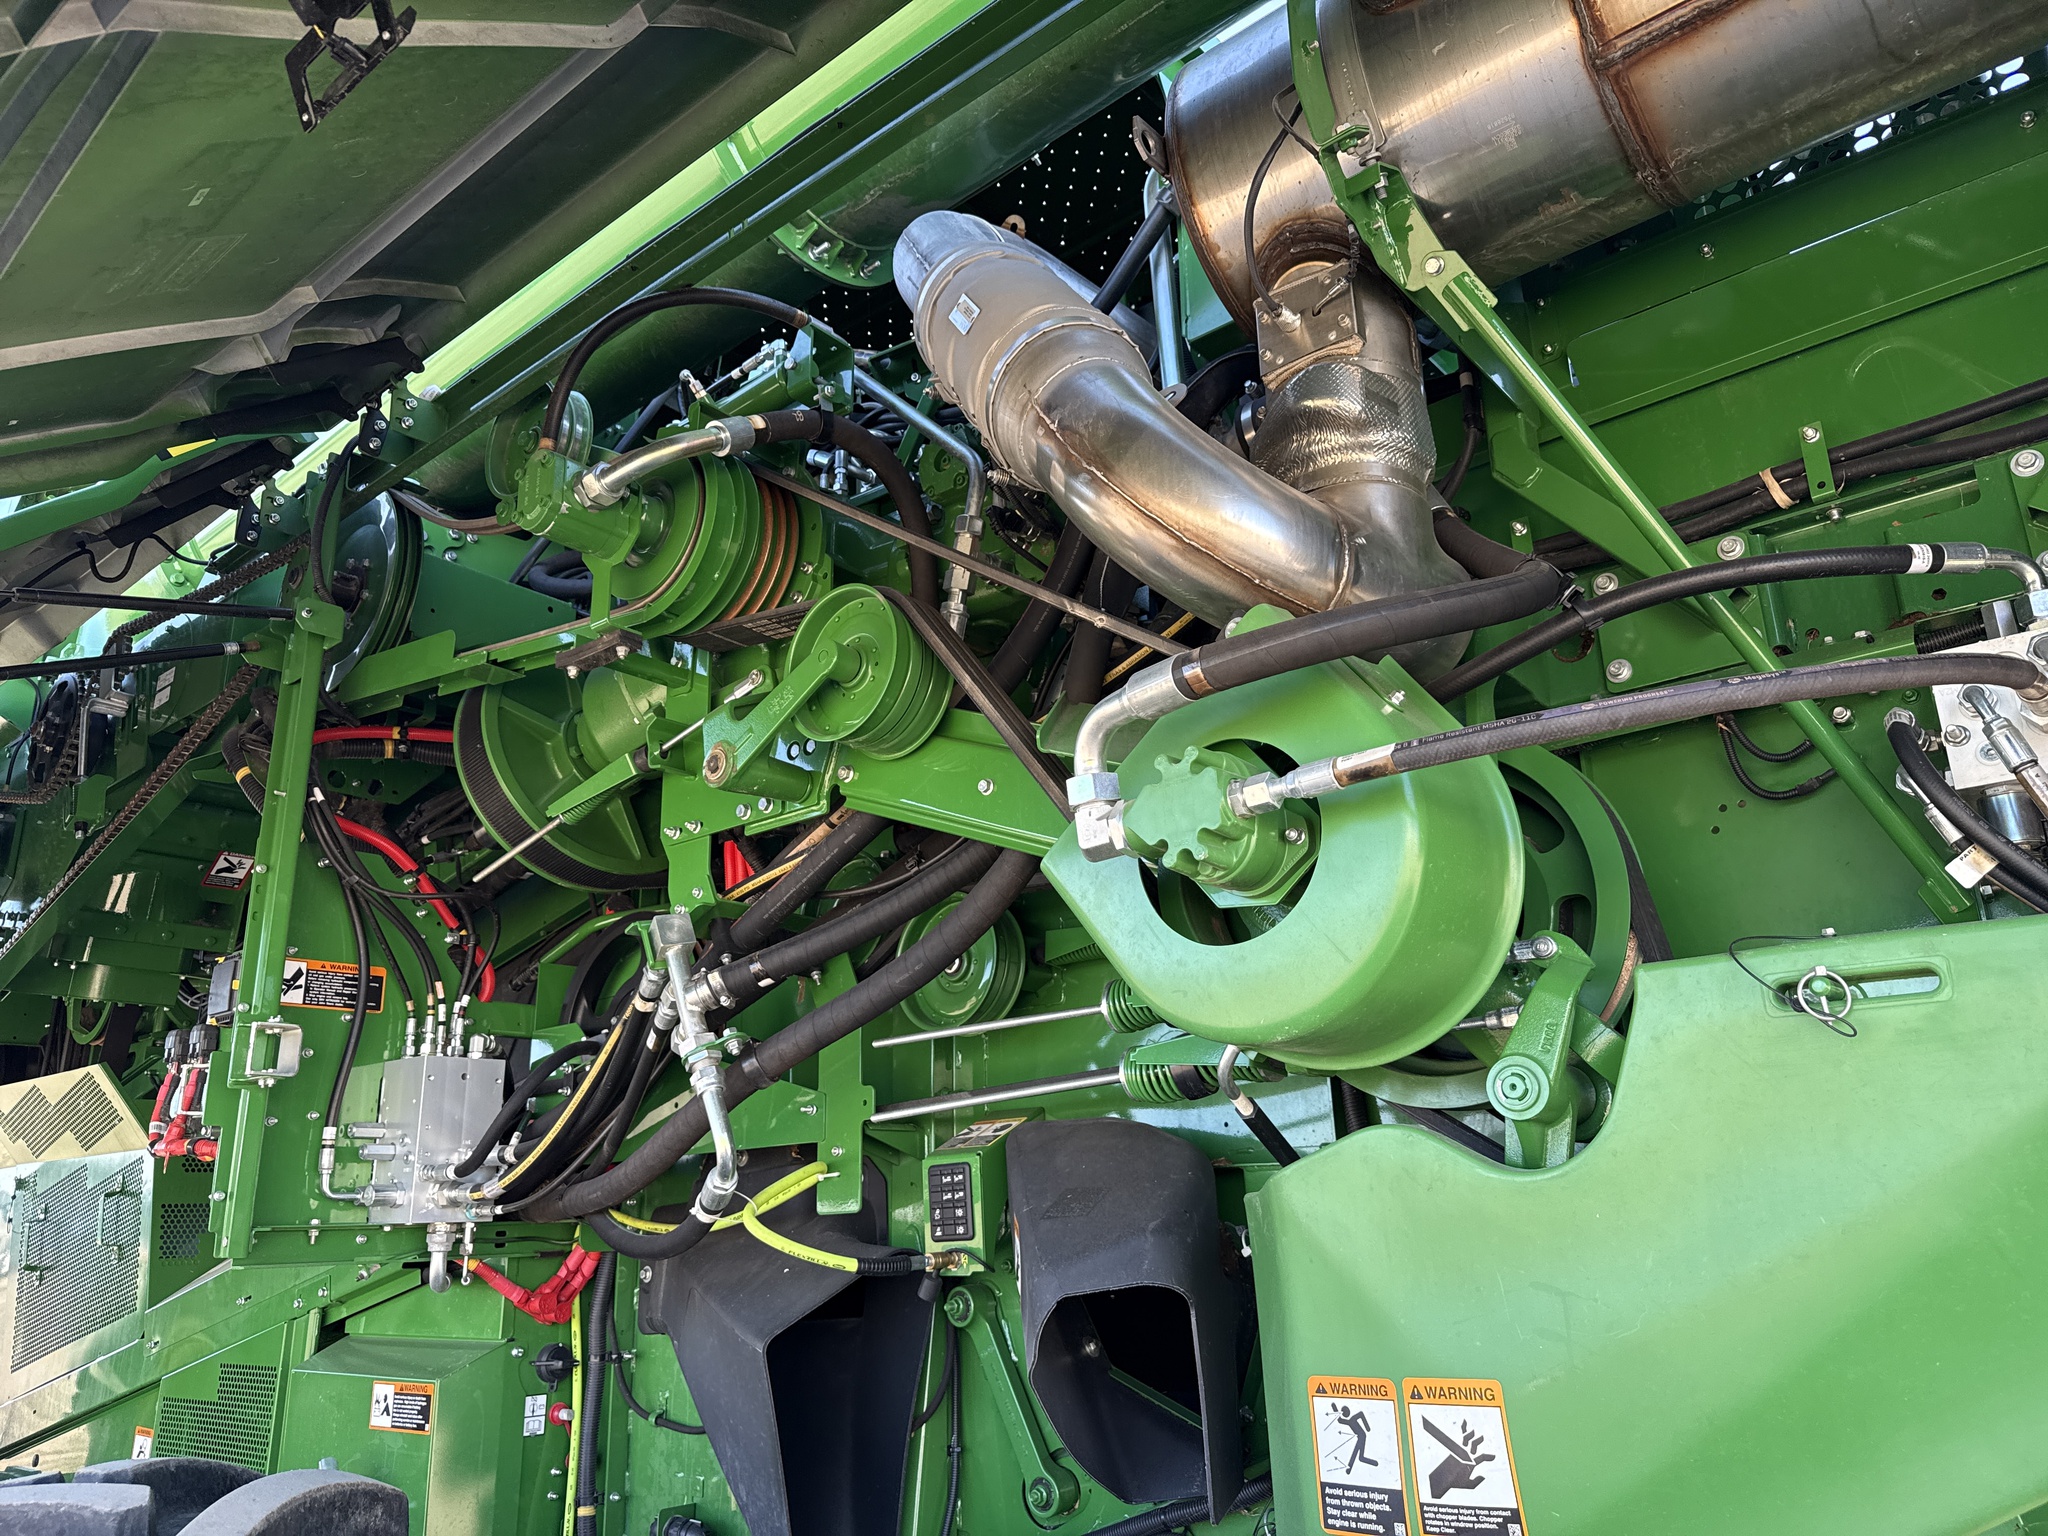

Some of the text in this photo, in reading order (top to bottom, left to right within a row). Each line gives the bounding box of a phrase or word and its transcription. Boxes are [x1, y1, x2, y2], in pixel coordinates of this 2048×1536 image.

[1598, 696, 1633, 706] POWERING
[1422, 734, 1445, 743] Flame
[1446, 726, 1481, 738] Resistant
[1482, 720, 1505, 730] MSHA
[1960, 845, 1978, 862] PART
[330, 964, 359, 973] WARNIN
[404, 1384, 428, 1393] WARNING
[1329, 1382, 1388, 1397] WARNING
[1424, 1386, 1496, 1402] WARNING
[1325, 1486, 1388, 1502] Avoid serious injury
[1326, 1496, 1392, 1512] from thrown objects.
[1326, 1507, 1376, 1520] Stay clear while
[1459, 1508, 1474, 1516] injury
[1328, 1518, 1386, 1533] engine is running.
